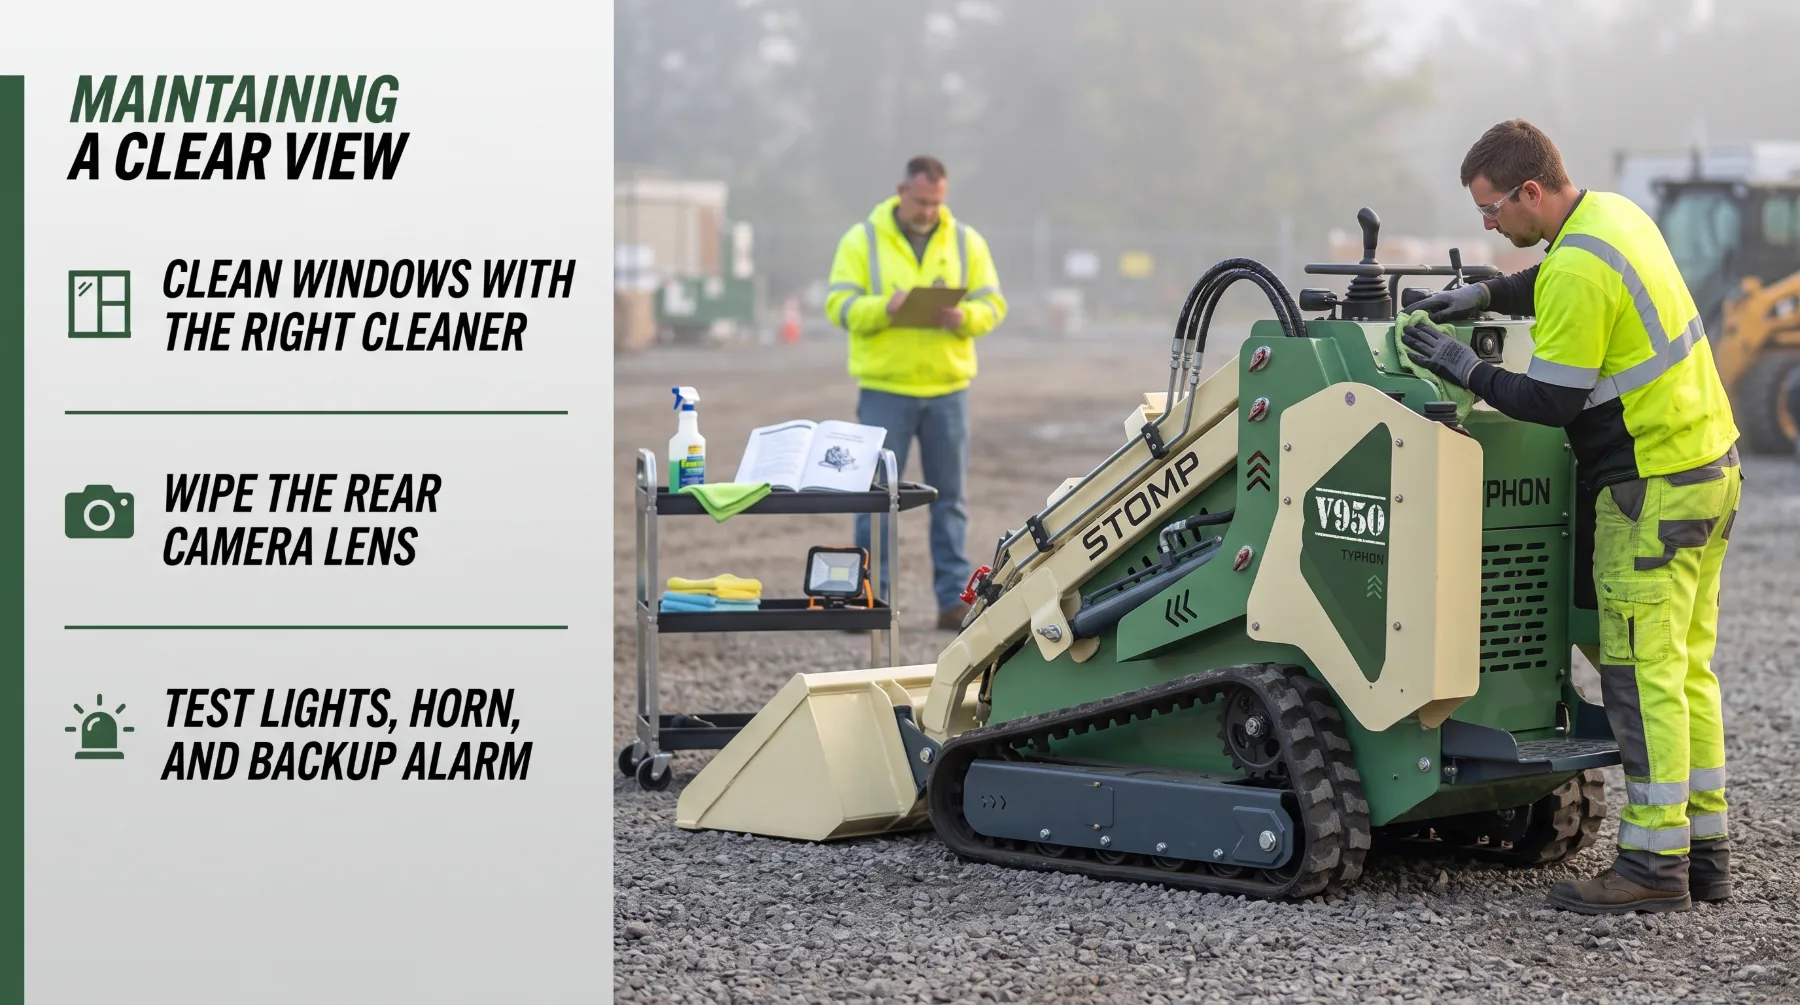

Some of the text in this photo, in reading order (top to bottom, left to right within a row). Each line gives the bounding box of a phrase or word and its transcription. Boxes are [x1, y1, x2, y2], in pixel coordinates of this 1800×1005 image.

[1083, 451, 1199, 561] STOMP
[1483, 477, 1551, 508] PHON
[1315, 495, 1385, 537] V950
[1341, 548, 1385, 566] TYPHON
